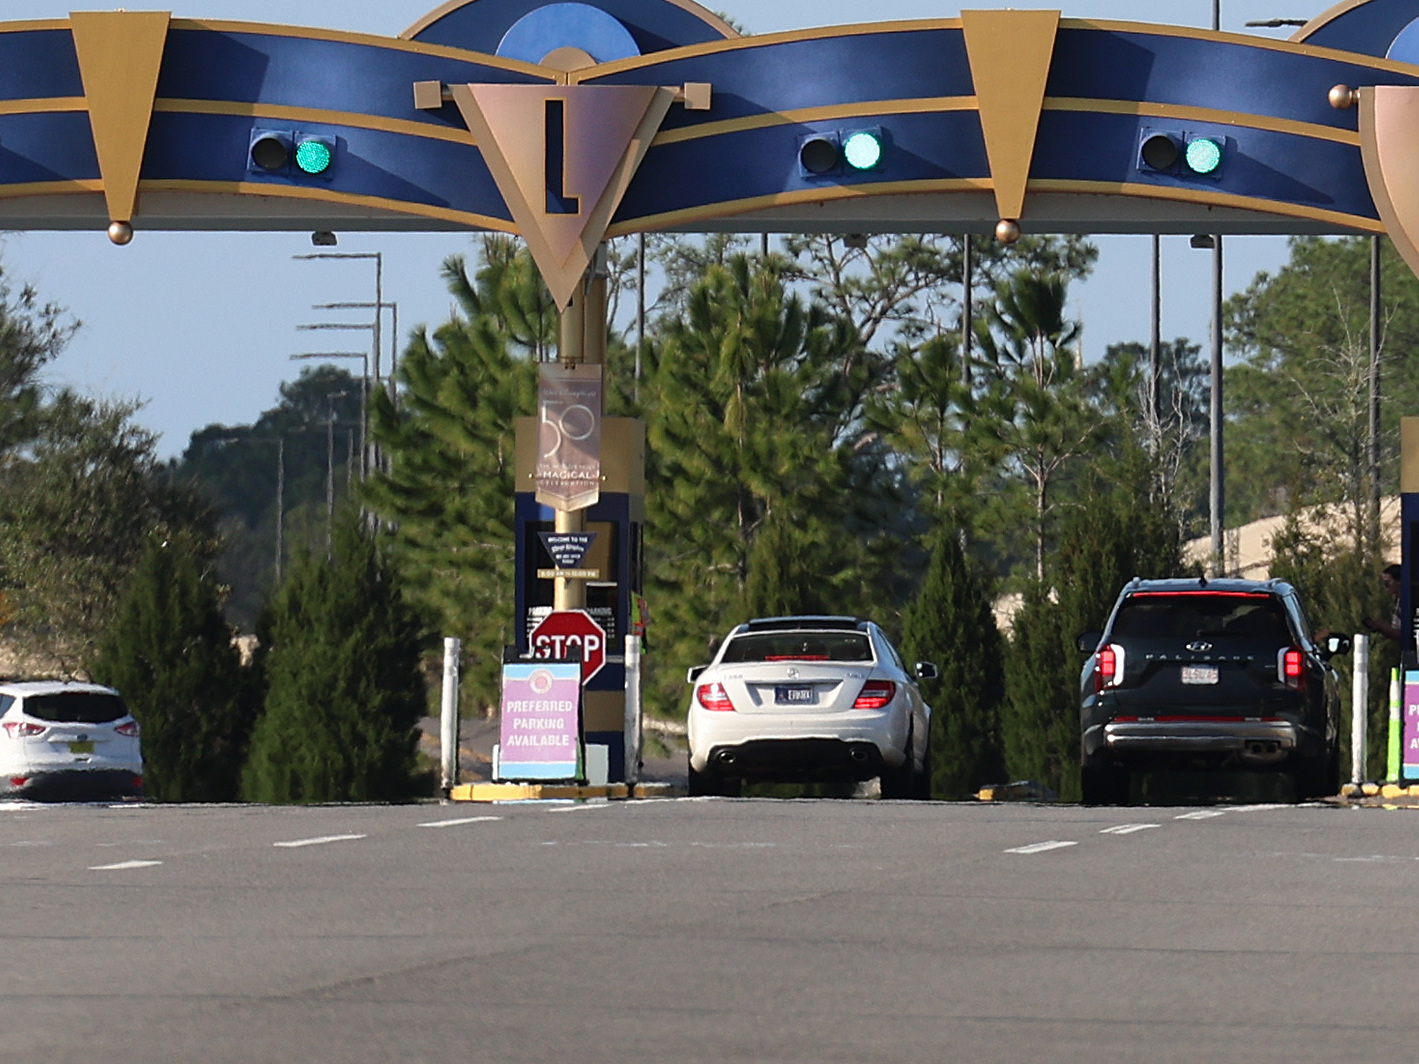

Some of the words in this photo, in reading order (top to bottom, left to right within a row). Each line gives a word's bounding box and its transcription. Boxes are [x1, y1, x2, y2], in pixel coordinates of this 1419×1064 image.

[545, 98, 581, 215] L
[541, 400, 595, 459] 50
[543, 471, 591, 479] MAGICAL
[506, 700, 573, 713] PREFERRED
[512, 718, 564, 729] PARKING
[505, 734, 570, 747] AVAILABLE
